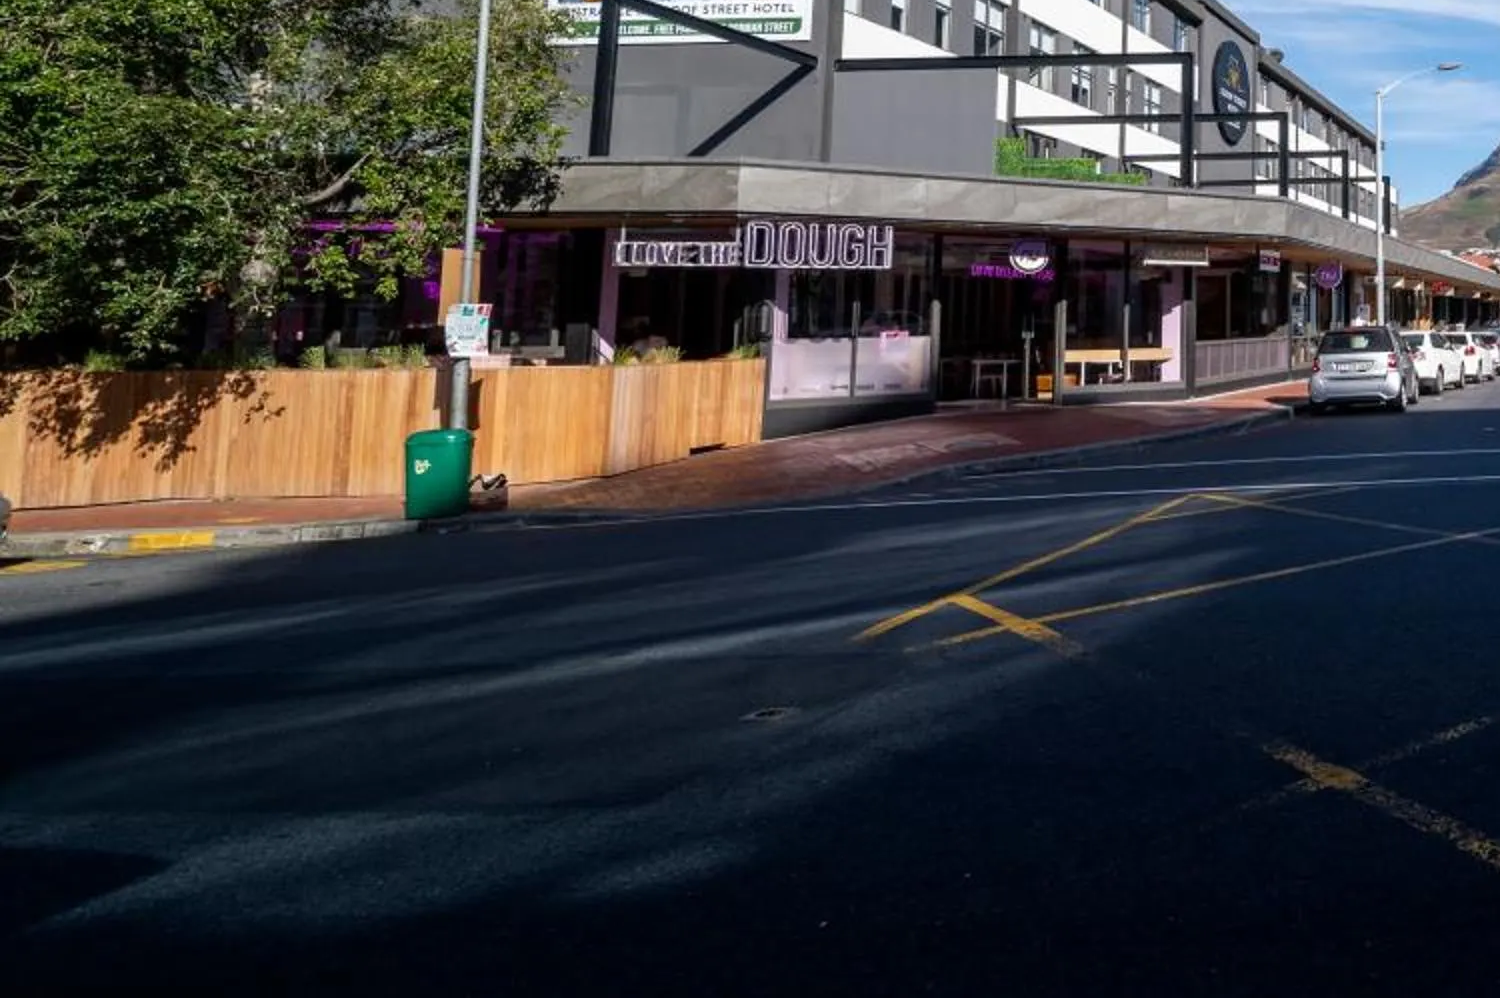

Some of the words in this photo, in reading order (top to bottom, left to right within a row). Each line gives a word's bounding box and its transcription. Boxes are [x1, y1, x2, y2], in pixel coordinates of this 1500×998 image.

[703, 3, 749, 15] STREET
[753, 2, 795, 14] HOTEL
[745, 221, 894, 269] DOUGH
